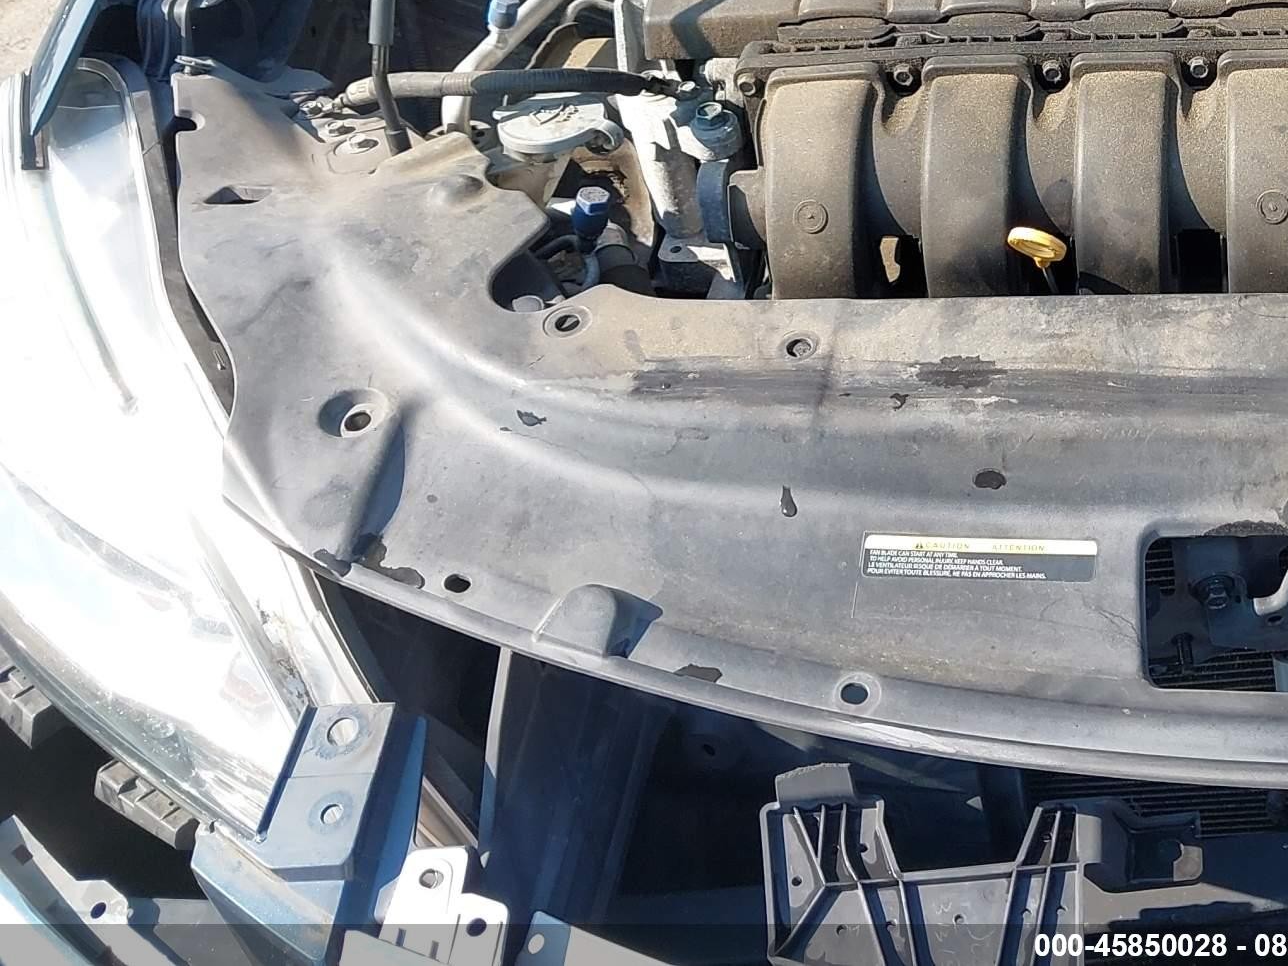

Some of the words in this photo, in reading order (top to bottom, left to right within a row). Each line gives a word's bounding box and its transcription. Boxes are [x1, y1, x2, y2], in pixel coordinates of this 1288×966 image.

[925, 541, 969, 549] CAUTION
[992, 543, 1044, 551] ATTENTION
[875, 561, 912, 569] VENTILATEUR
[981, 570, 1015, 578] APPROCHER
